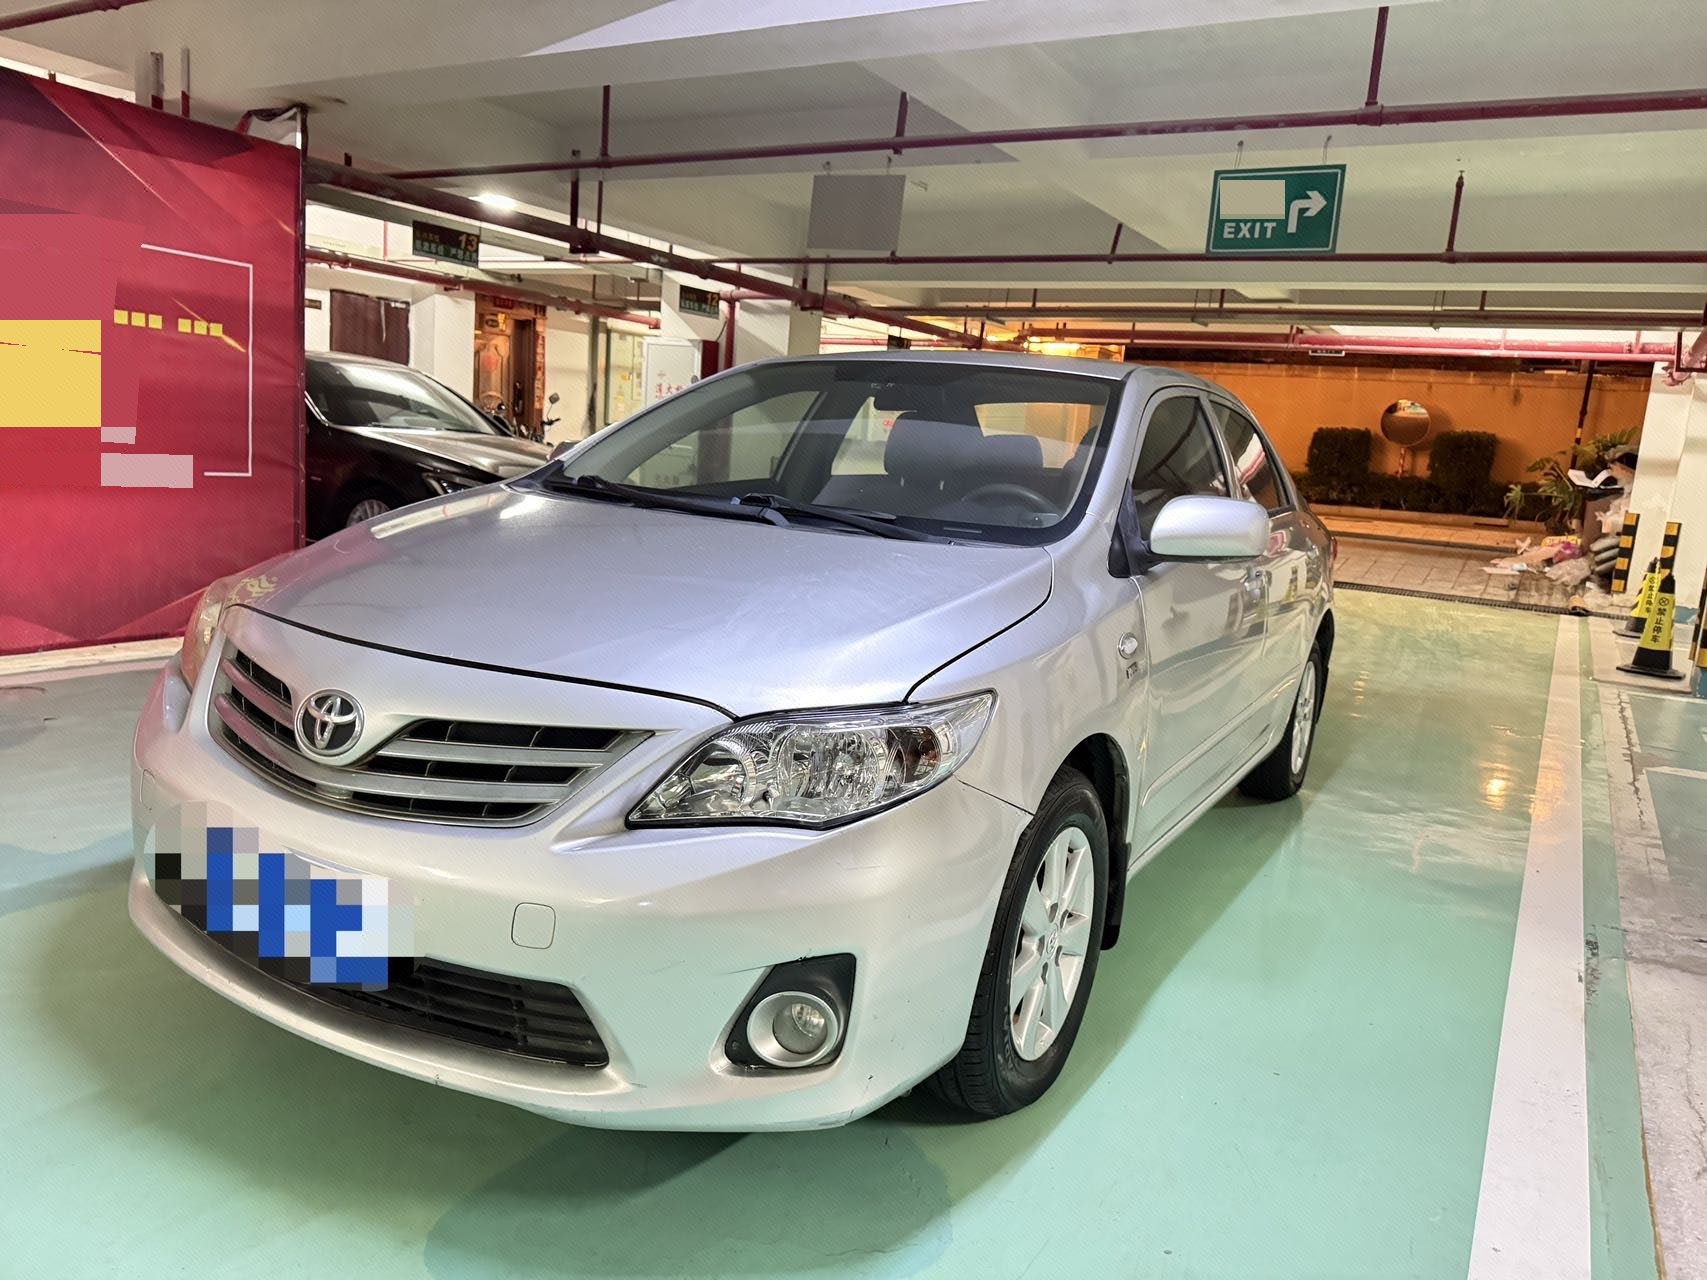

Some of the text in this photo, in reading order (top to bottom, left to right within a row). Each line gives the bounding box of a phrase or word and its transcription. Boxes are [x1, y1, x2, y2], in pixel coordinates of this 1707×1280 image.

[1223, 222, 1276, 239] EXIT
[458, 233, 479, 252] 13
[706, 292, 719, 305] 12
[1651, 607, 1667, 644] 禁止停车
